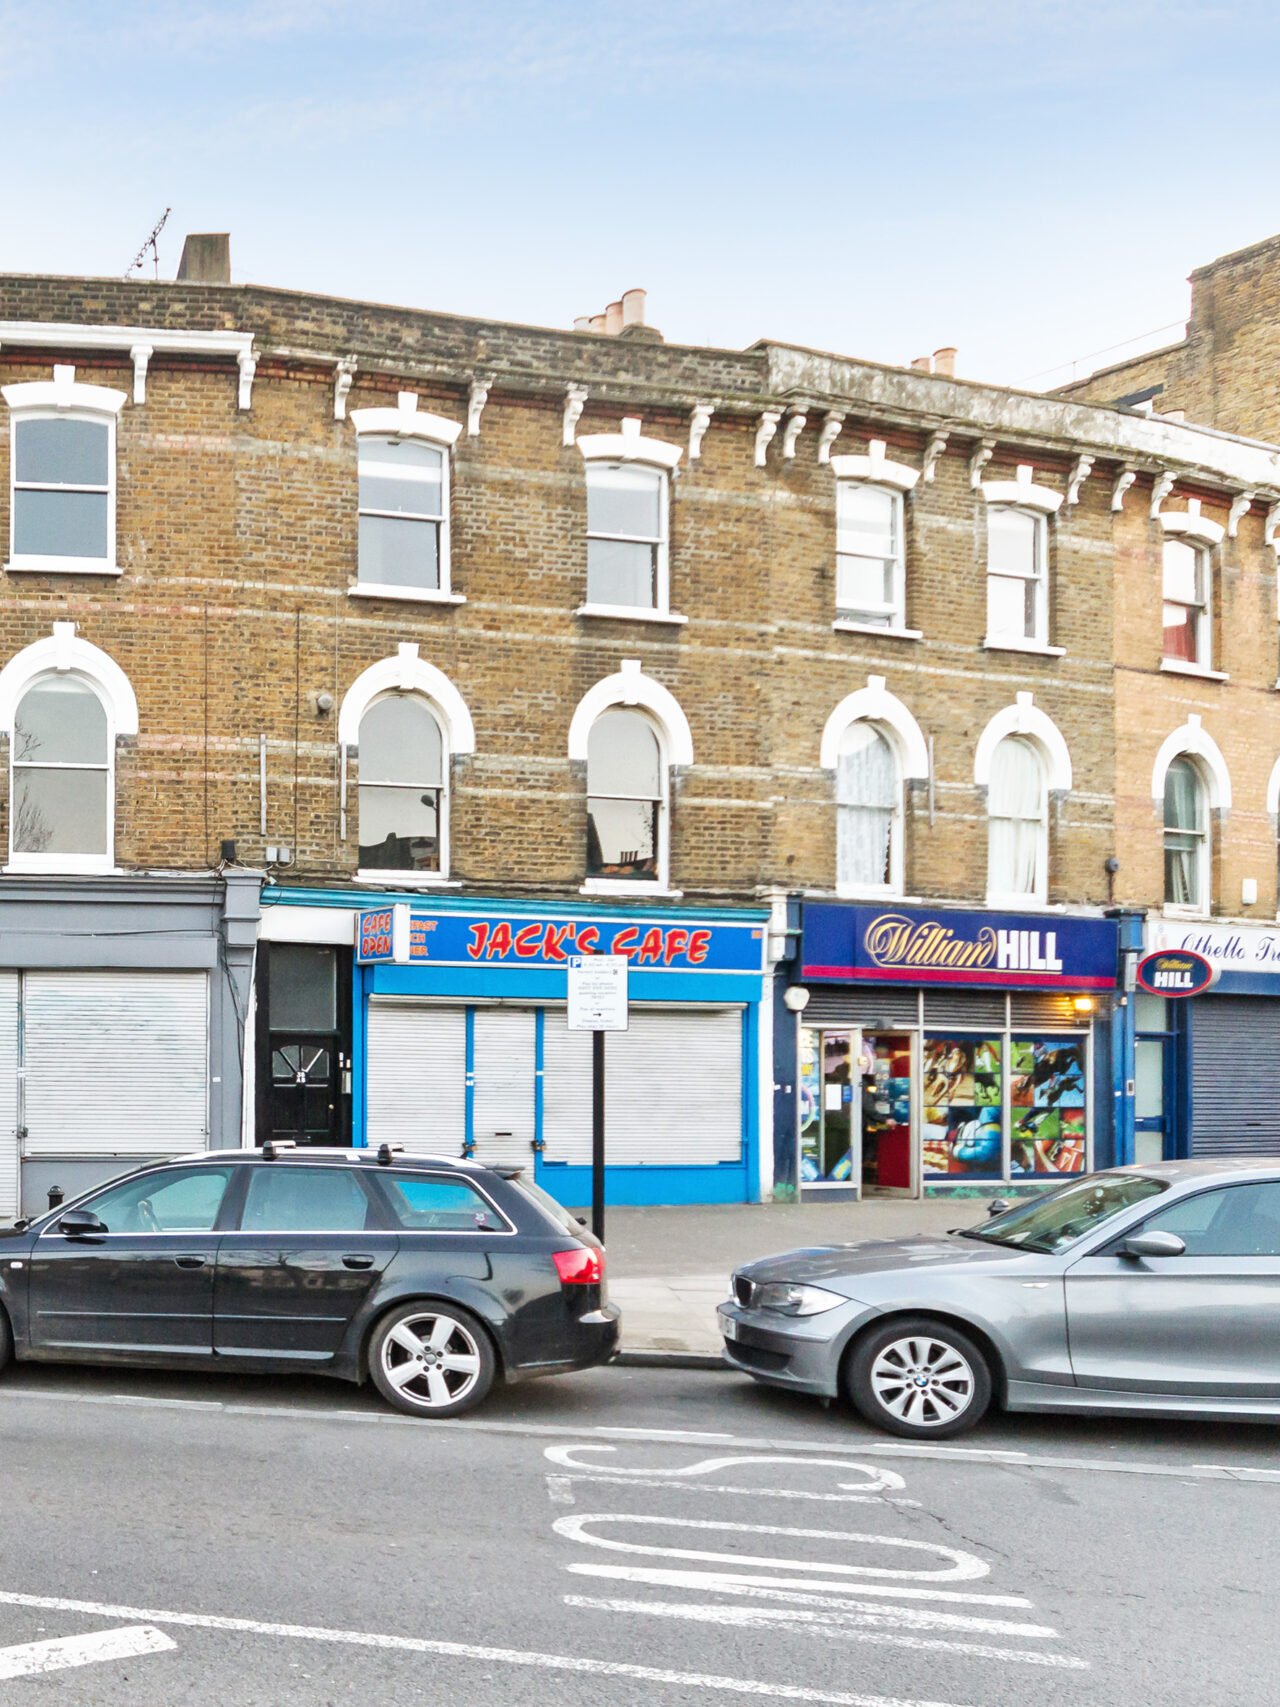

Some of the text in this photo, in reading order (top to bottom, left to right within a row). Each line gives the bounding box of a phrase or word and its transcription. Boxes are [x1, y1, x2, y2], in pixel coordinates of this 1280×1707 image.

[363, 912, 392, 935] CAFE
[362, 934, 392, 956] OPEN
[467, 922, 711, 965] JACK'S CAFE
[865, 914, 1063, 971] William HILL
[1154, 972, 1194, 988] HILL
